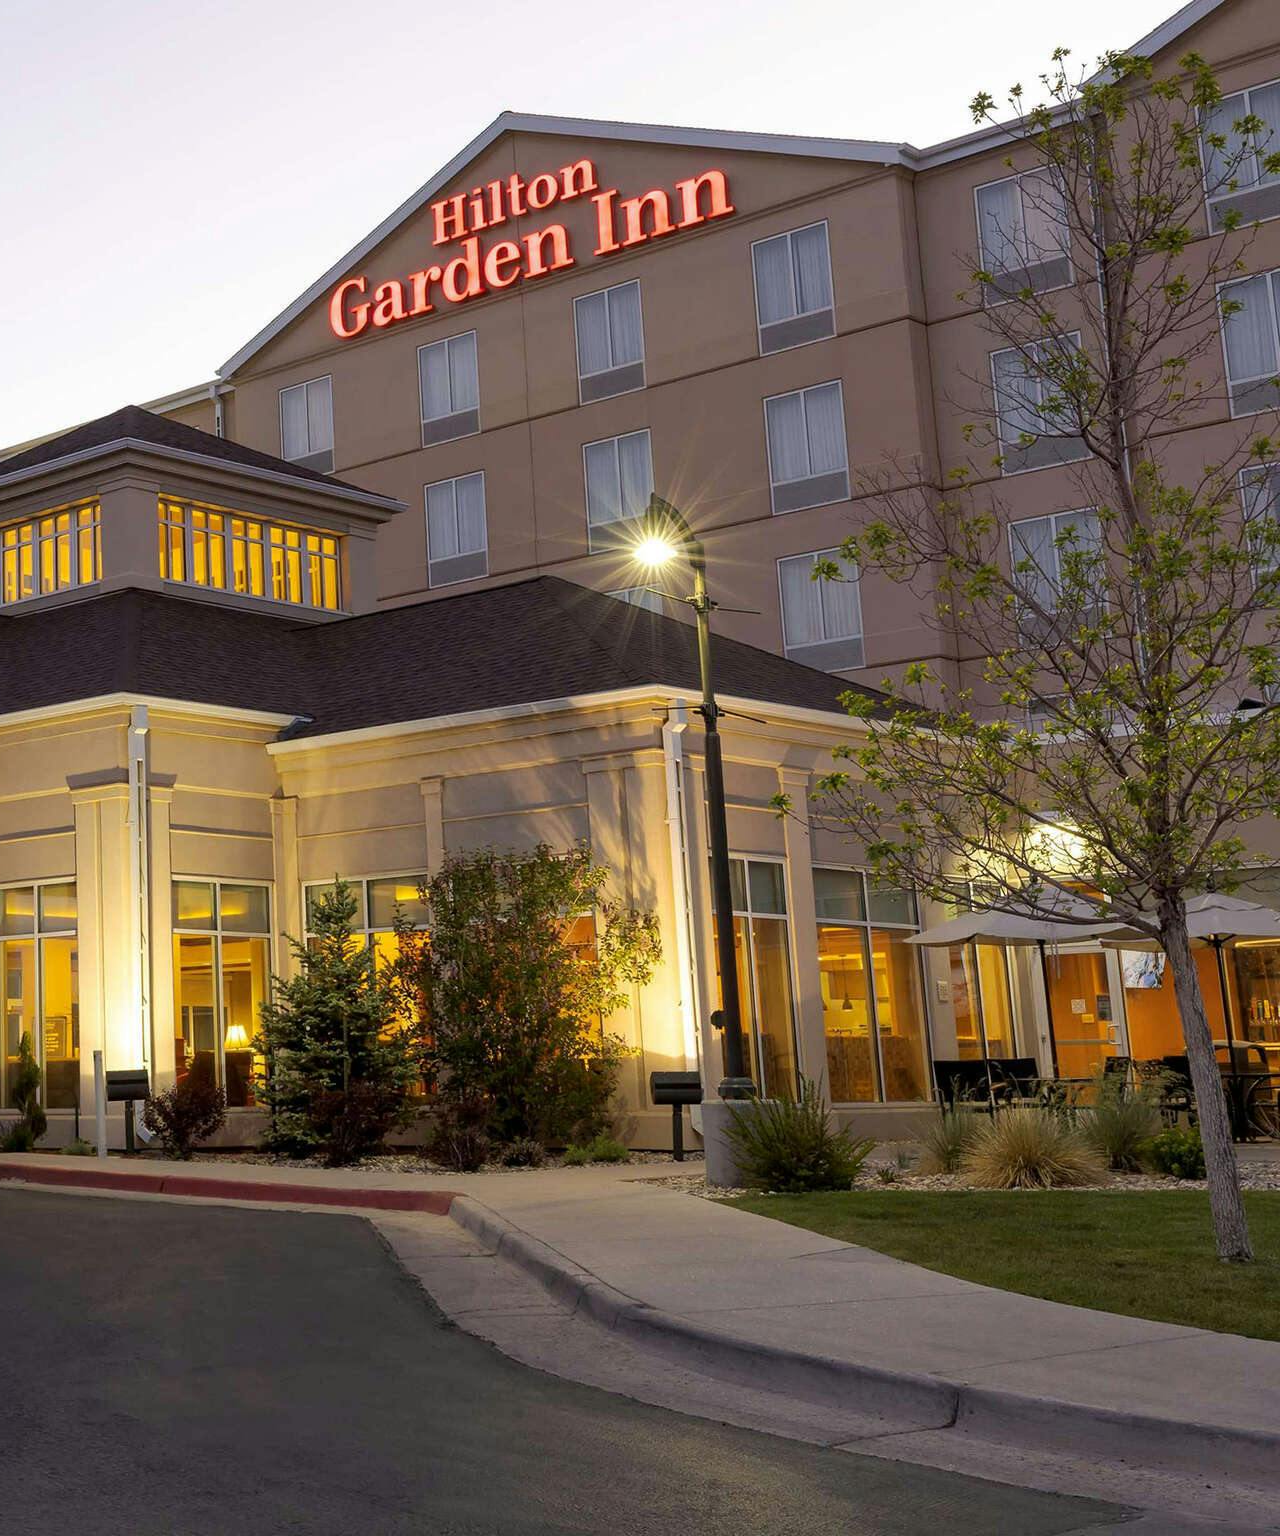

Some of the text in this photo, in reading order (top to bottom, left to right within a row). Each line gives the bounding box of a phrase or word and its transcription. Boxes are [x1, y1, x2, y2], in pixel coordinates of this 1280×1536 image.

[328, 167, 735, 339] Garden Inn
[431, 158, 598, 246] Hilton
